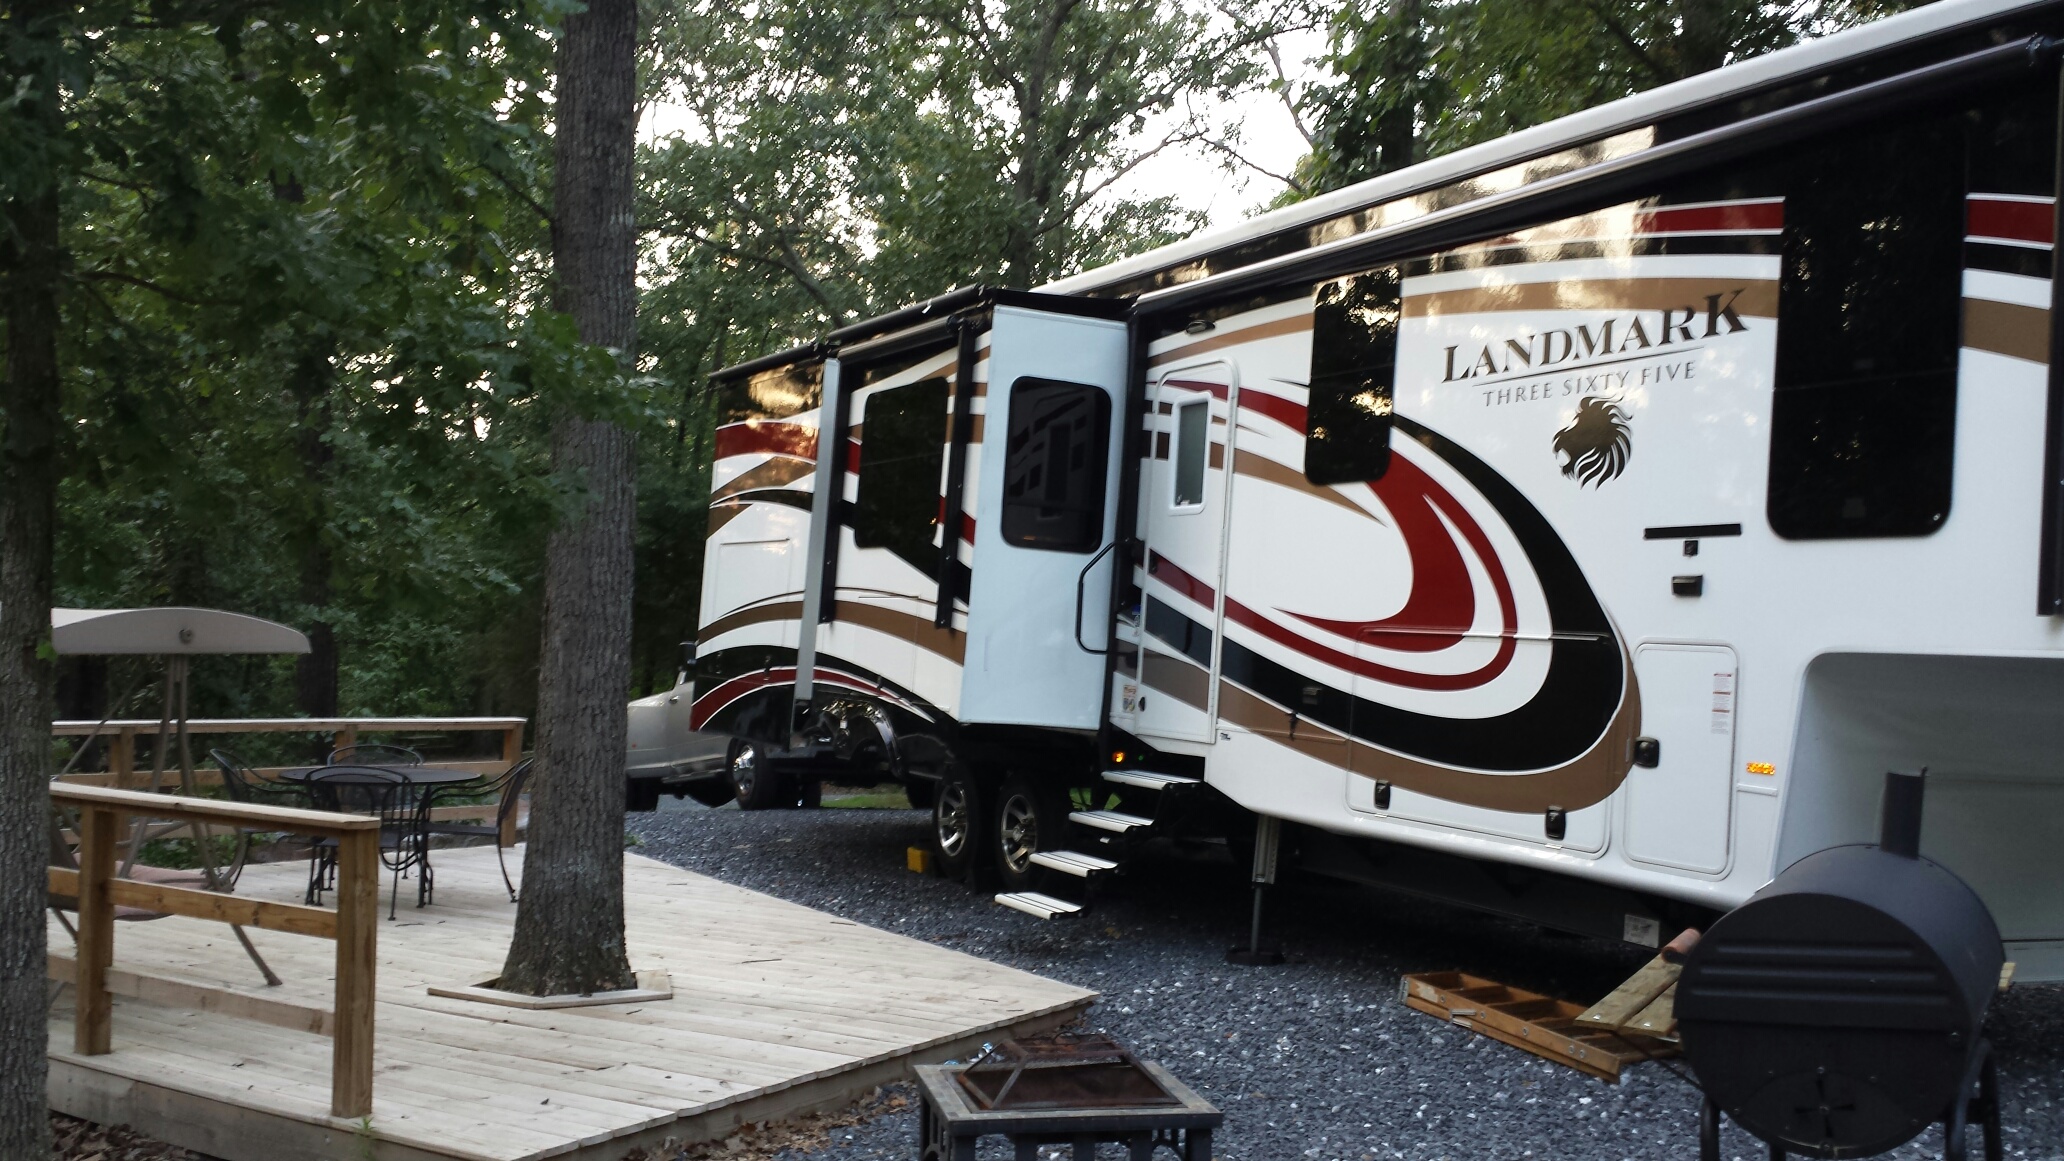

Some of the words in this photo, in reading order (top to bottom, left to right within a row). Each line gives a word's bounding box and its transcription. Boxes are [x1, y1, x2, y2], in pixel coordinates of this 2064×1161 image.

[1442, 288, 1748, 383] LANDMARK
[1483, 382, 1554, 407] THREE
[1563, 370, 1630, 396] SIXTY
[1640, 360, 1696, 387] FIVE
